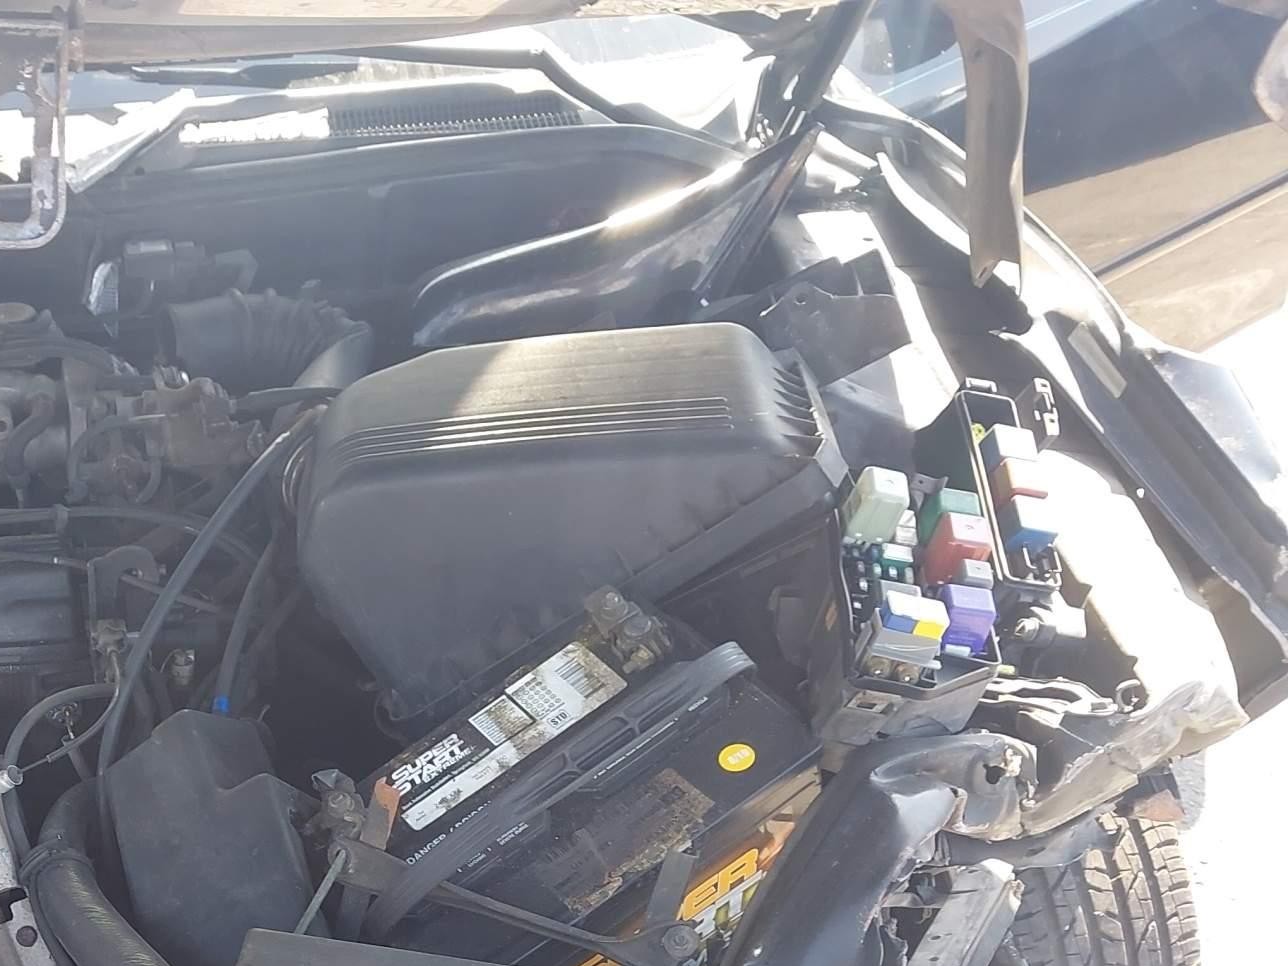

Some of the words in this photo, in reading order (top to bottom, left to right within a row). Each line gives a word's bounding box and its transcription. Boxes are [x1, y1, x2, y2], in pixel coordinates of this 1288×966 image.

[550, 711, 568, 727] STD
[391, 740, 465, 796] START
[392, 733, 458, 781] SUPER
